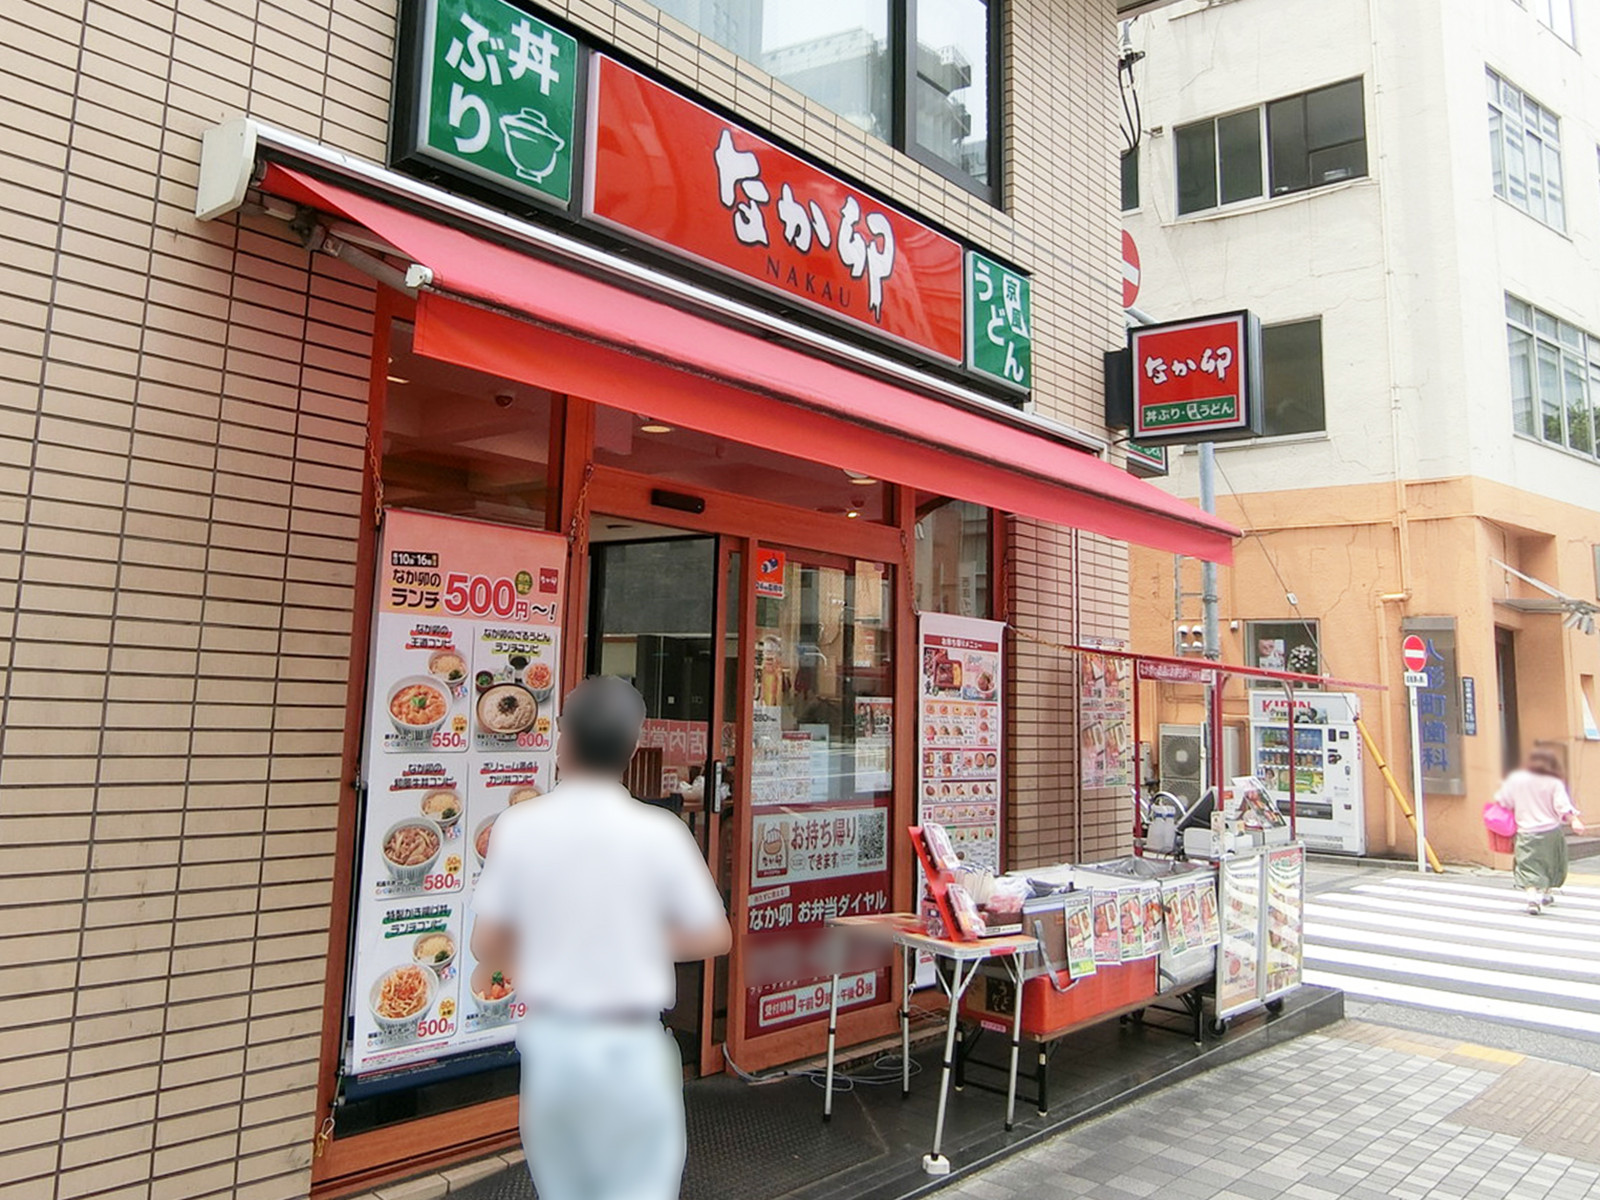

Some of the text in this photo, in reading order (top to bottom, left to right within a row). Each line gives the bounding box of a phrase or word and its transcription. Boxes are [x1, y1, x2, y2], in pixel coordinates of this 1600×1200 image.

[714, 129, 896, 323] なか卯
[766, 255, 851, 308] NAKAU
[975, 260, 1025, 382] うどん
[1144, 346, 1232, 384] なか卯
[393, 569, 441, 587] なか卯の
[392, 588, 440, 609] ランチ
[432, 732, 466, 748] 550円
[791, 817, 857, 850] お持ち帰り
[424, 873, 461, 891] 580円
[749, 903, 793, 931] なか卯
[798, 890, 887, 922] お弁当ダイヤル
[417, 1018, 455, 1038] 500円
